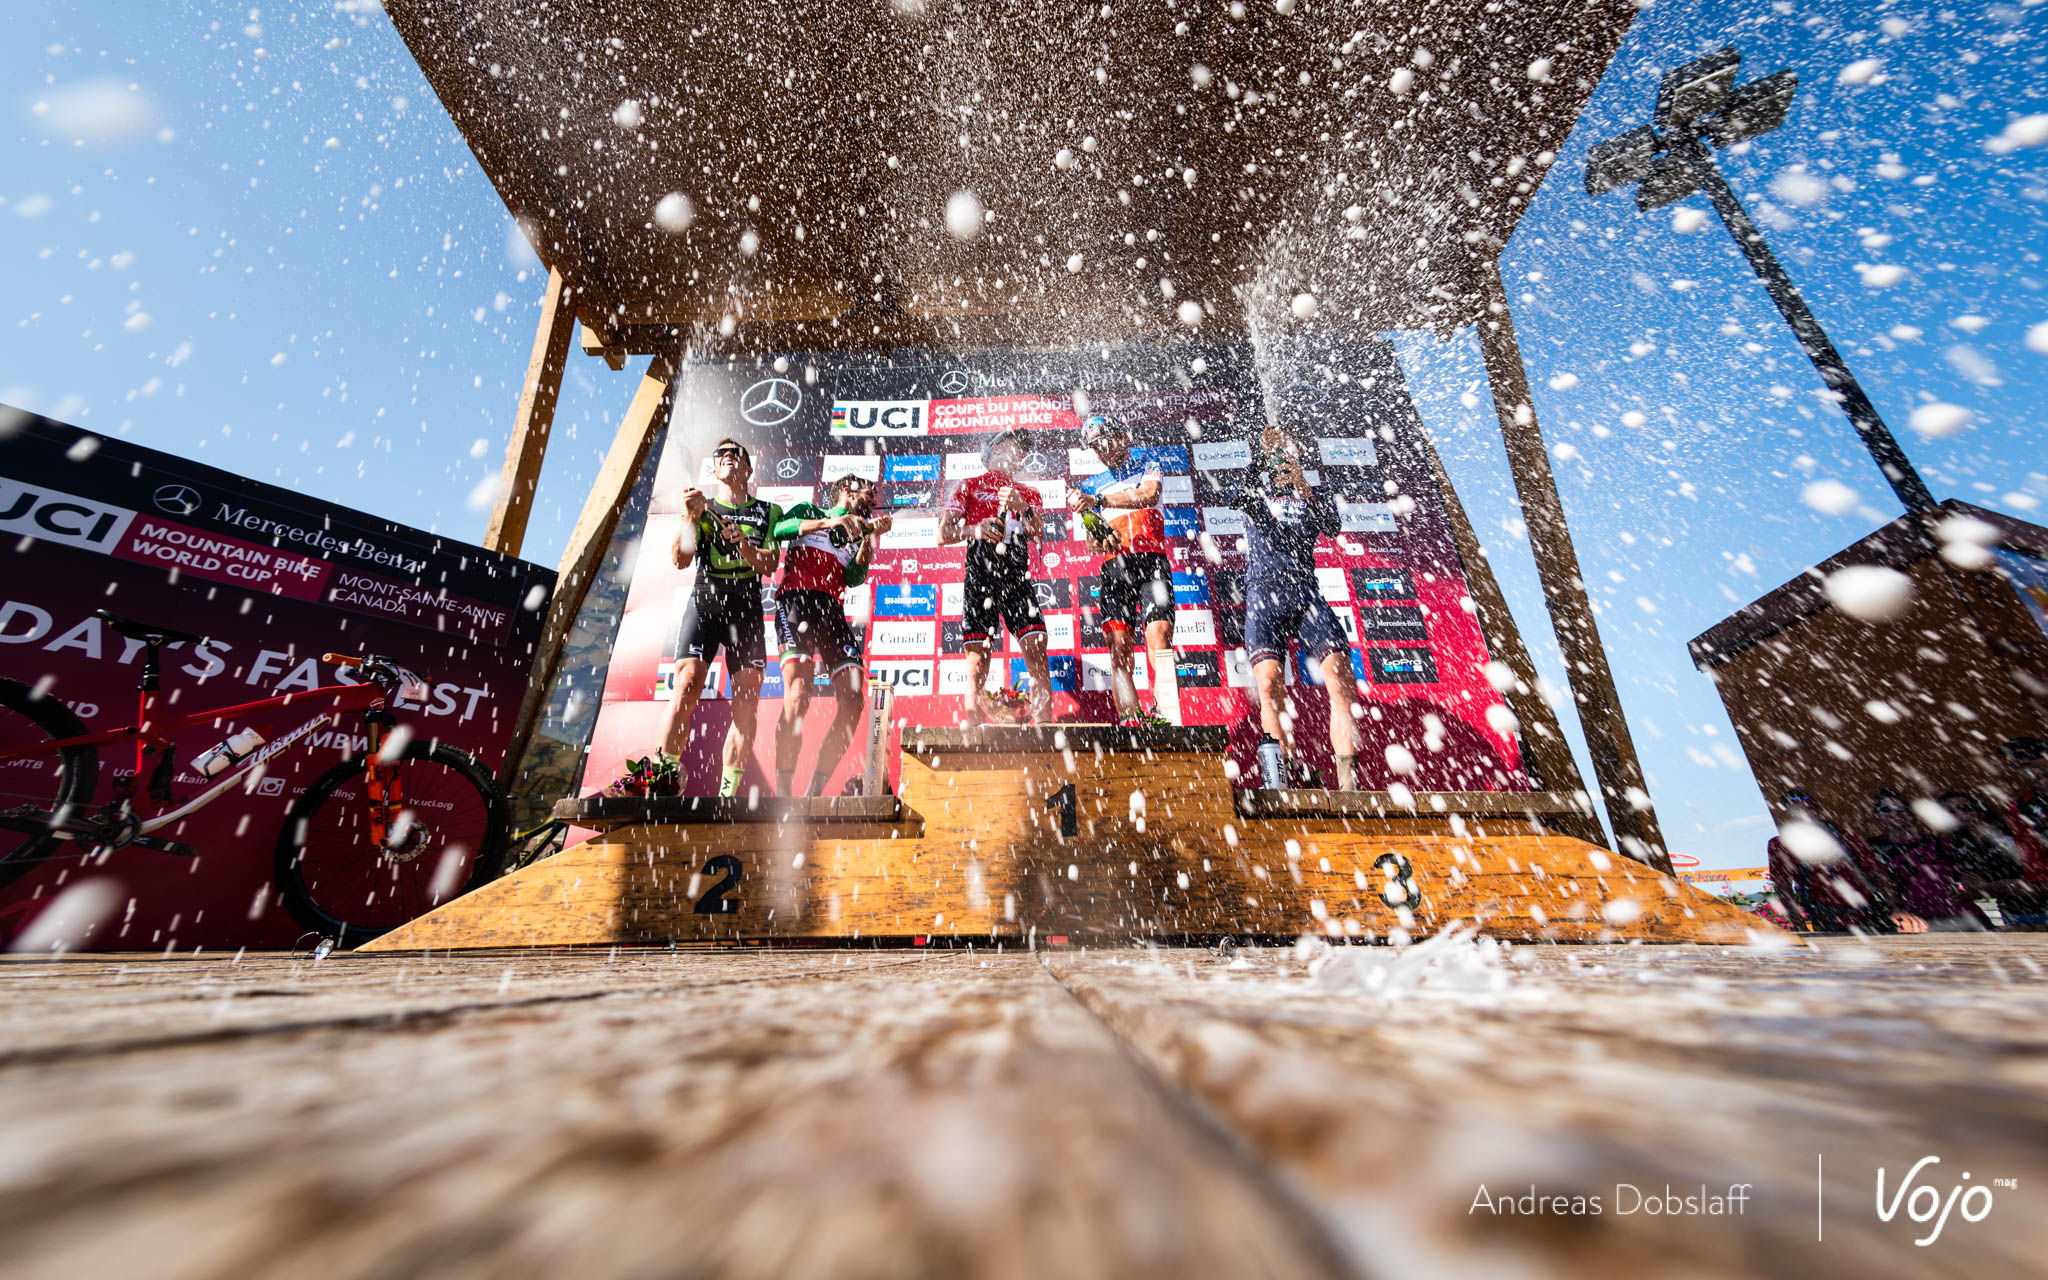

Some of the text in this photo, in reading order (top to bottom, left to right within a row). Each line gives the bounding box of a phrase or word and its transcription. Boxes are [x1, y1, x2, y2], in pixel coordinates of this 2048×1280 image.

[850, 406, 921, 430] UCI
[935, 398, 1072, 416] COUPE DU MONDE
[934, 412, 1053, 429] MOUNTAIN BIKE
[0, 485, 119, 543] UCI
[212, 502, 424, 573] Mercedes-Benz
[132, 538, 273, 582] WORLD CUP
[139, 523, 322, 579] MOUNTAIN BIKE
[333, 588, 408, 615] CANADA
[338, 573, 506, 625] MONT-SAINTE-ANNE
[1174, 622, 1207, 633] nada
[1376, 620, 1424, 628] Mercedes-Benz
[880, 632, 927, 643] Canada
[1384, 658, 1422, 667] GoPro
[881, 668, 930, 687] UCI
[409, 798, 454, 811] tv.uci.org
[1048, 783, 1077, 837] 1
[693, 854, 743, 914] 2
[1373, 852, 1423, 911] 3
